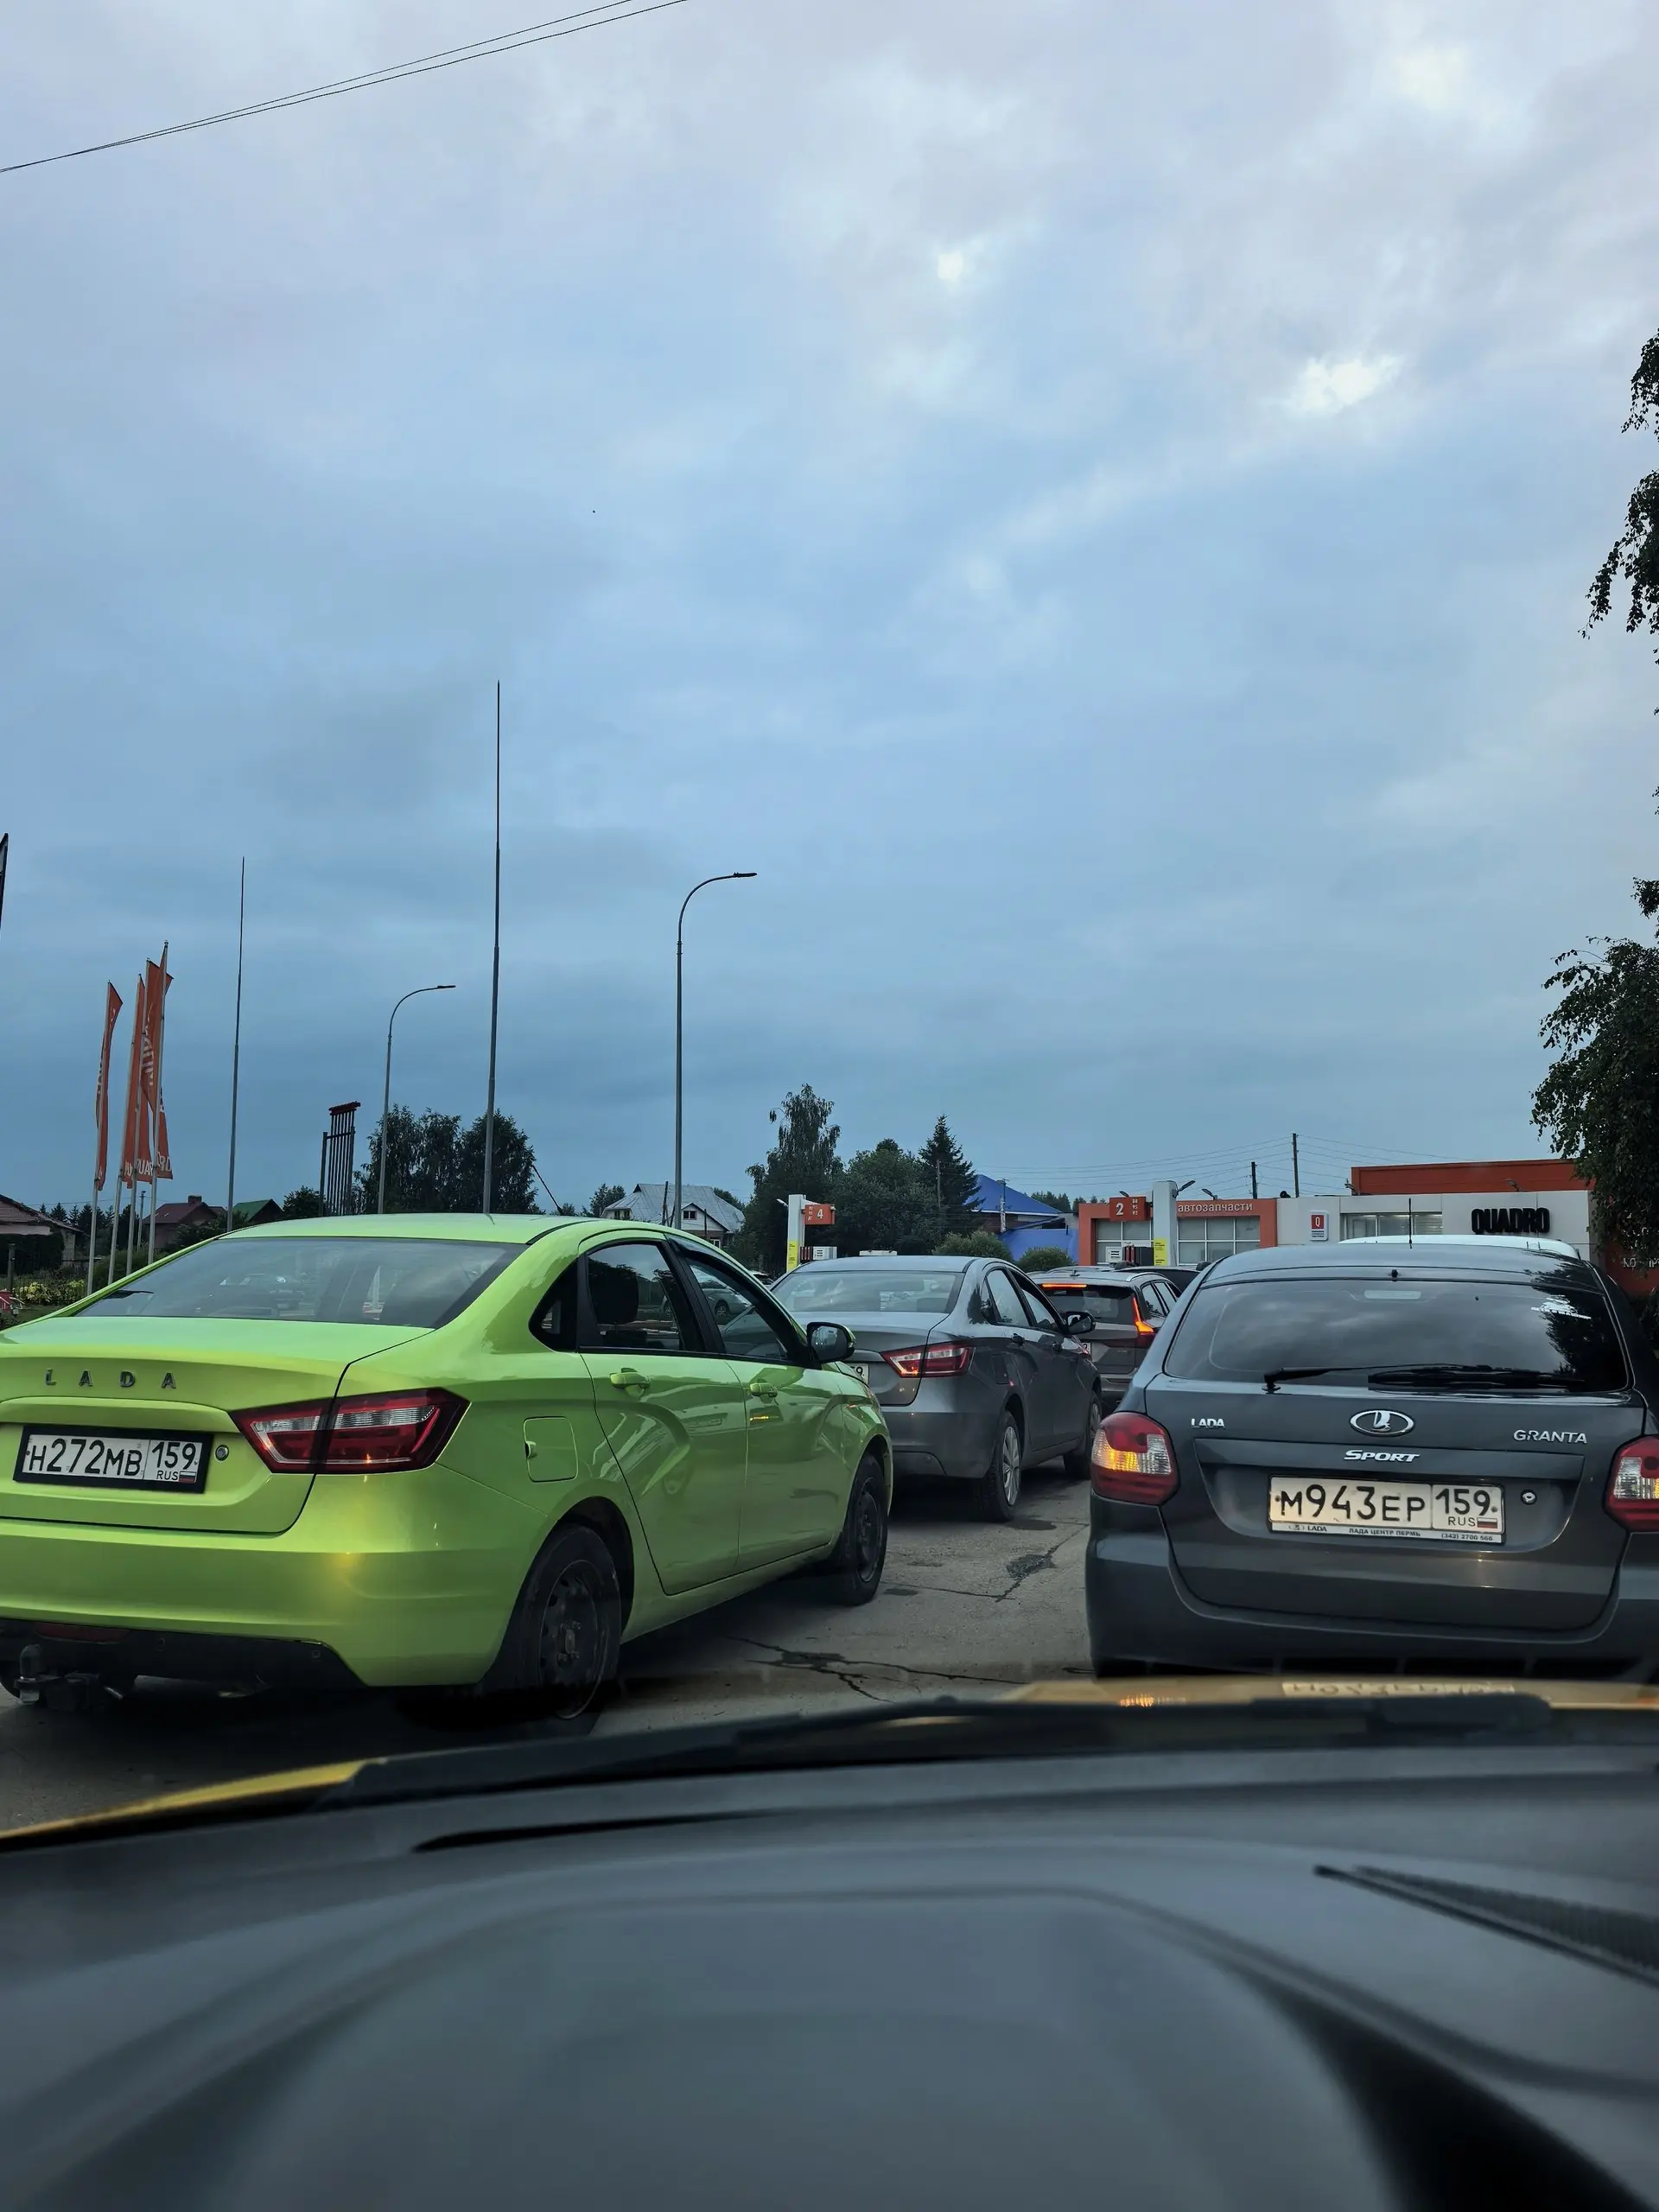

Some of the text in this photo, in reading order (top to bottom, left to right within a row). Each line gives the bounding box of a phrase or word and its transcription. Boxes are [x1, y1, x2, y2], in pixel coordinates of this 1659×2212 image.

[817, 1208, 823, 1219] 4
[1116, 1202, 1123, 1216] 2
[1178, 1202, 1253, 1212] автозапчасти
[1315, 1217, 1320, 1228] Q
[1471, 1207, 1550, 1235] QUADRO
[46, 1369, 176, 1389] LADA
[1191, 1418, 1225, 1428] LADA
[1513, 1429, 1587, 1444] GRANTA
[152, 1441, 197, 1471] 159
[1344, 1449, 1420, 1462] SPORT
[156, 1470, 179, 1481] RUS
[1435, 1488, 1491, 1516] 159
[1448, 1516, 1476, 1527] RUS
